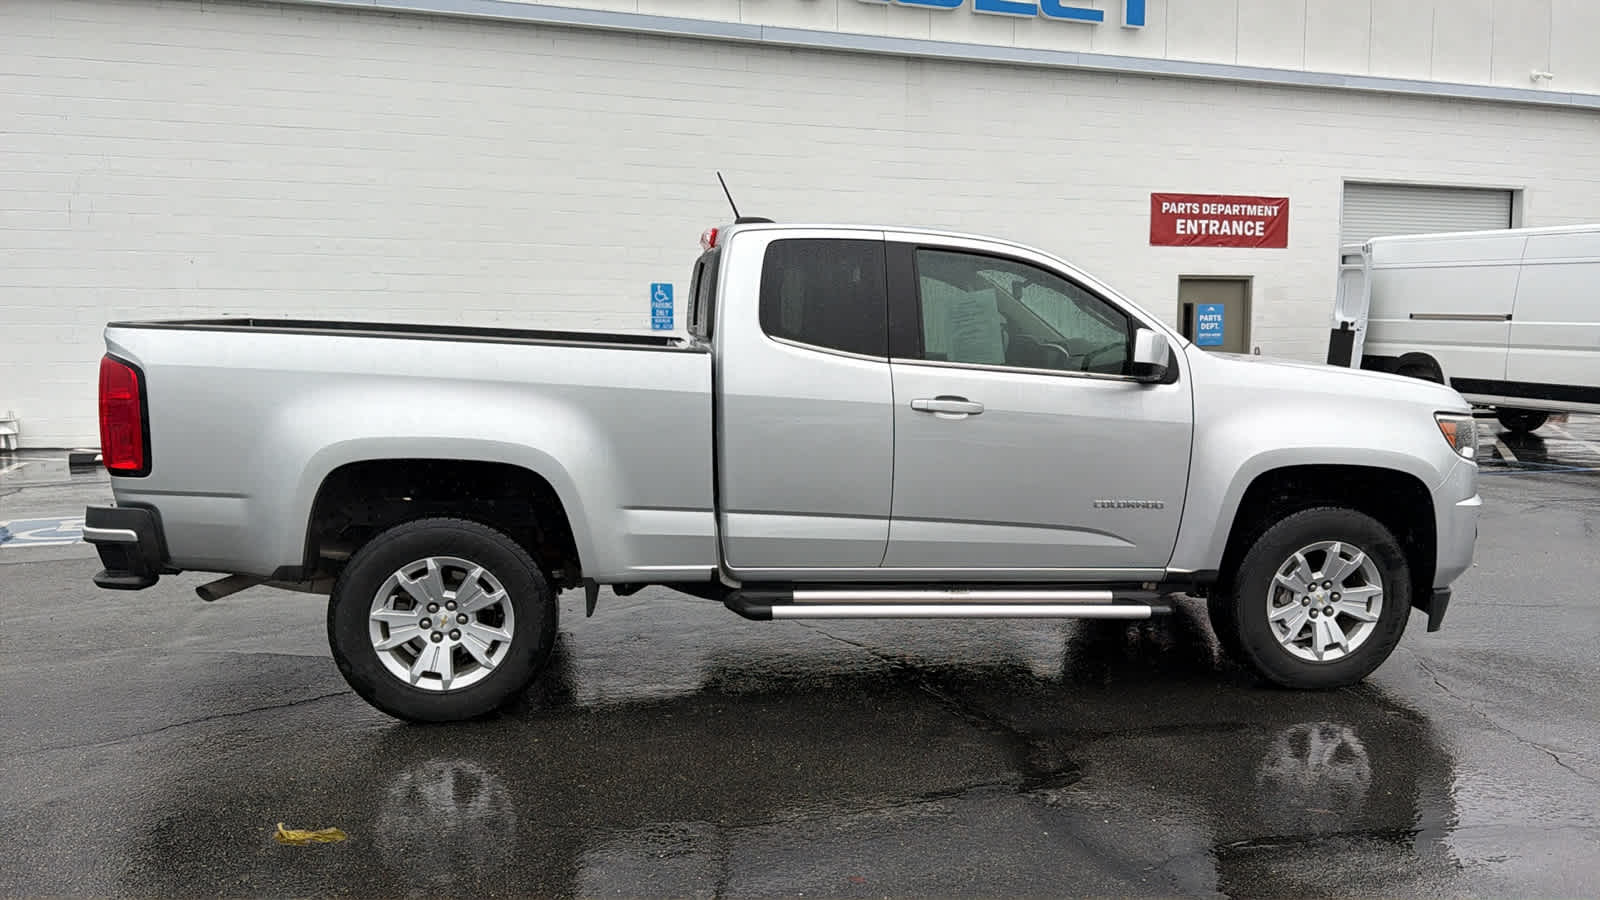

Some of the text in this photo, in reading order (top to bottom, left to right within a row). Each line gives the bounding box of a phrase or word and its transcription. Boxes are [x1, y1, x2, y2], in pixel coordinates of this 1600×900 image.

[1161, 202, 1279, 216] PARTS DEPARTMENT
[1175, 219, 1265, 236] ENTRANCE
[1199, 314, 1222, 322] PARTS
[1093, 499, 1164, 509] COLORADO
